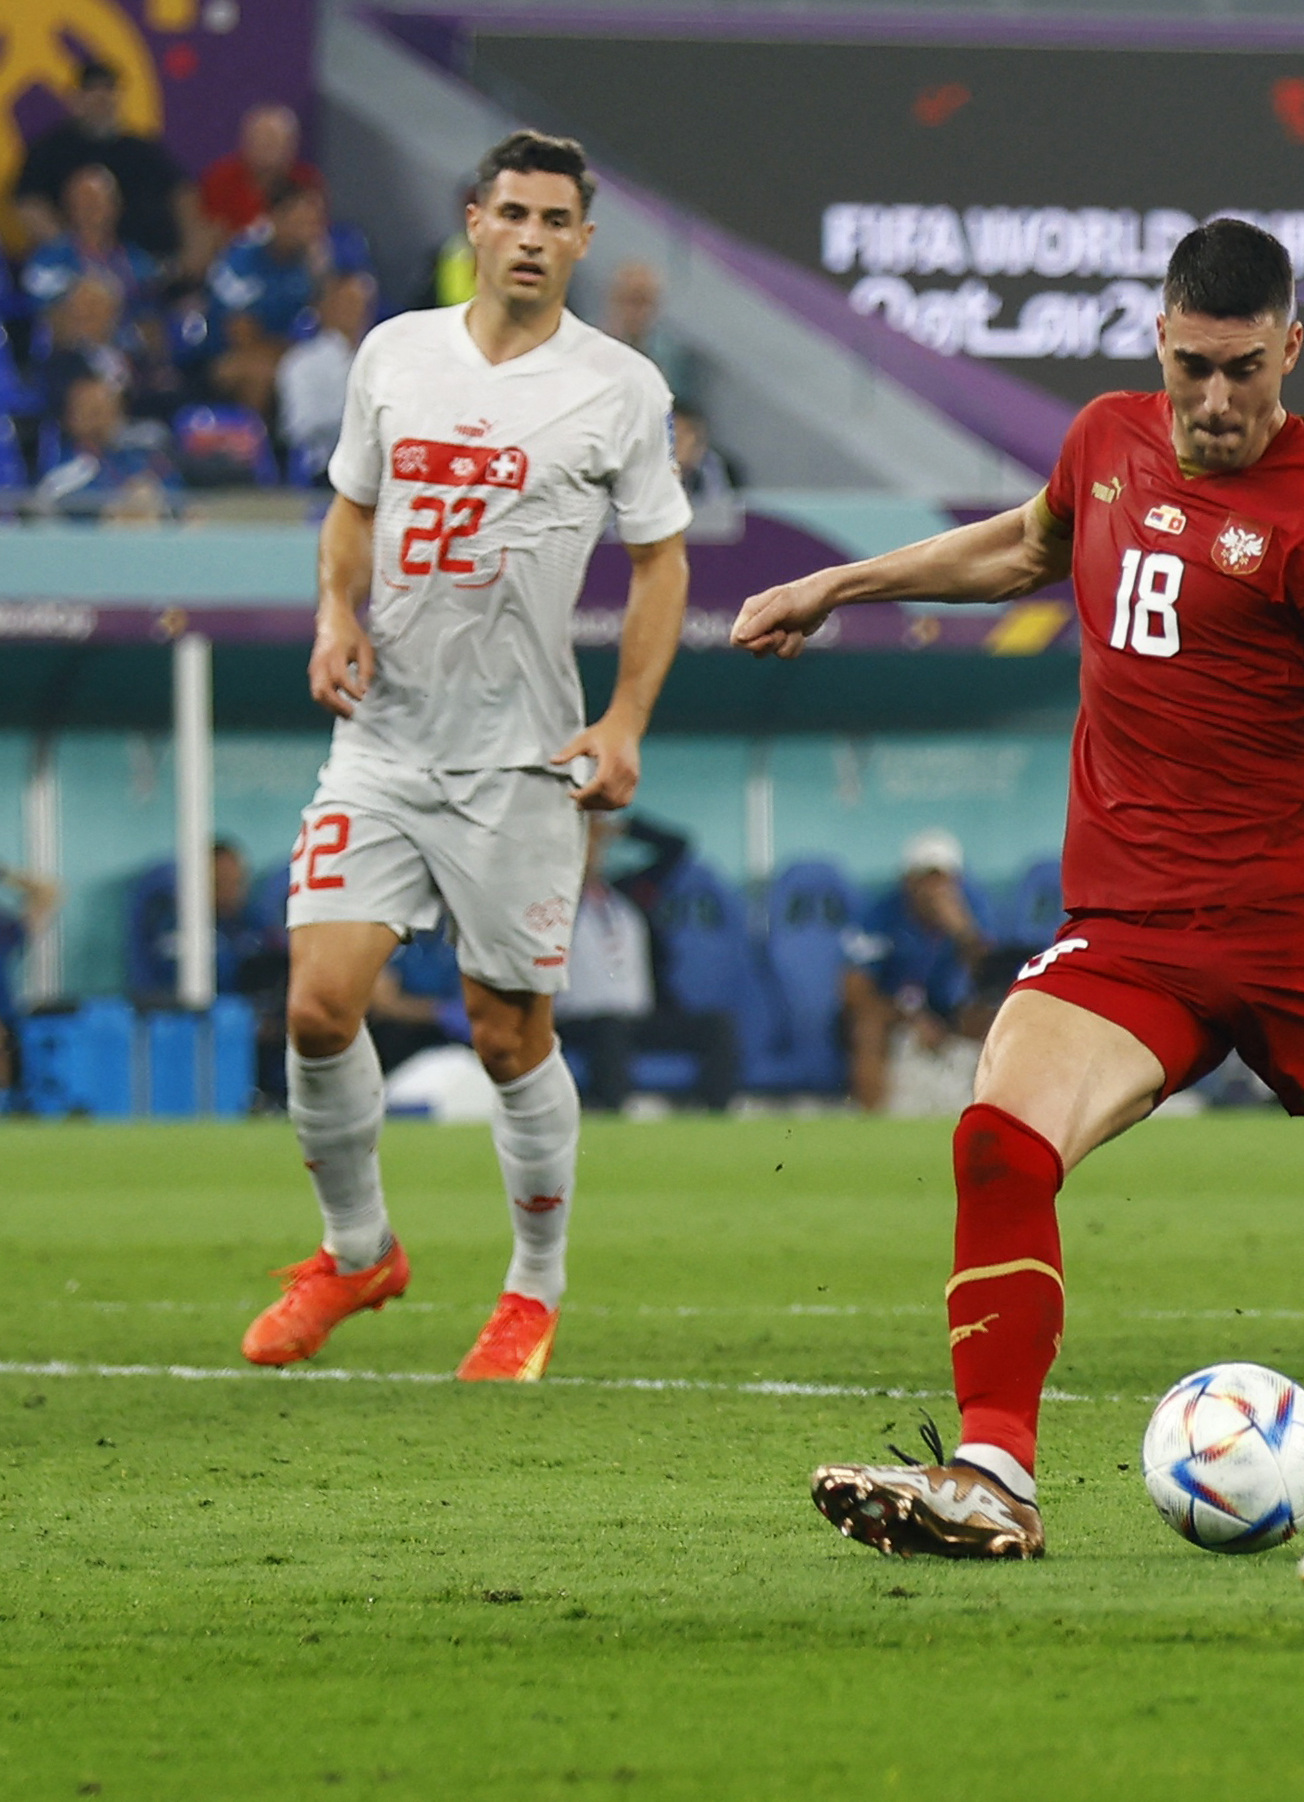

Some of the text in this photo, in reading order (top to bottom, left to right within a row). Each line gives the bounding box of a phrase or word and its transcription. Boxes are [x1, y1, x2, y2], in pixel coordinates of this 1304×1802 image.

[822, 202, 968, 274] FIFA
[400, 495, 487, 576] 22
[1109, 549, 1185, 658] 18
